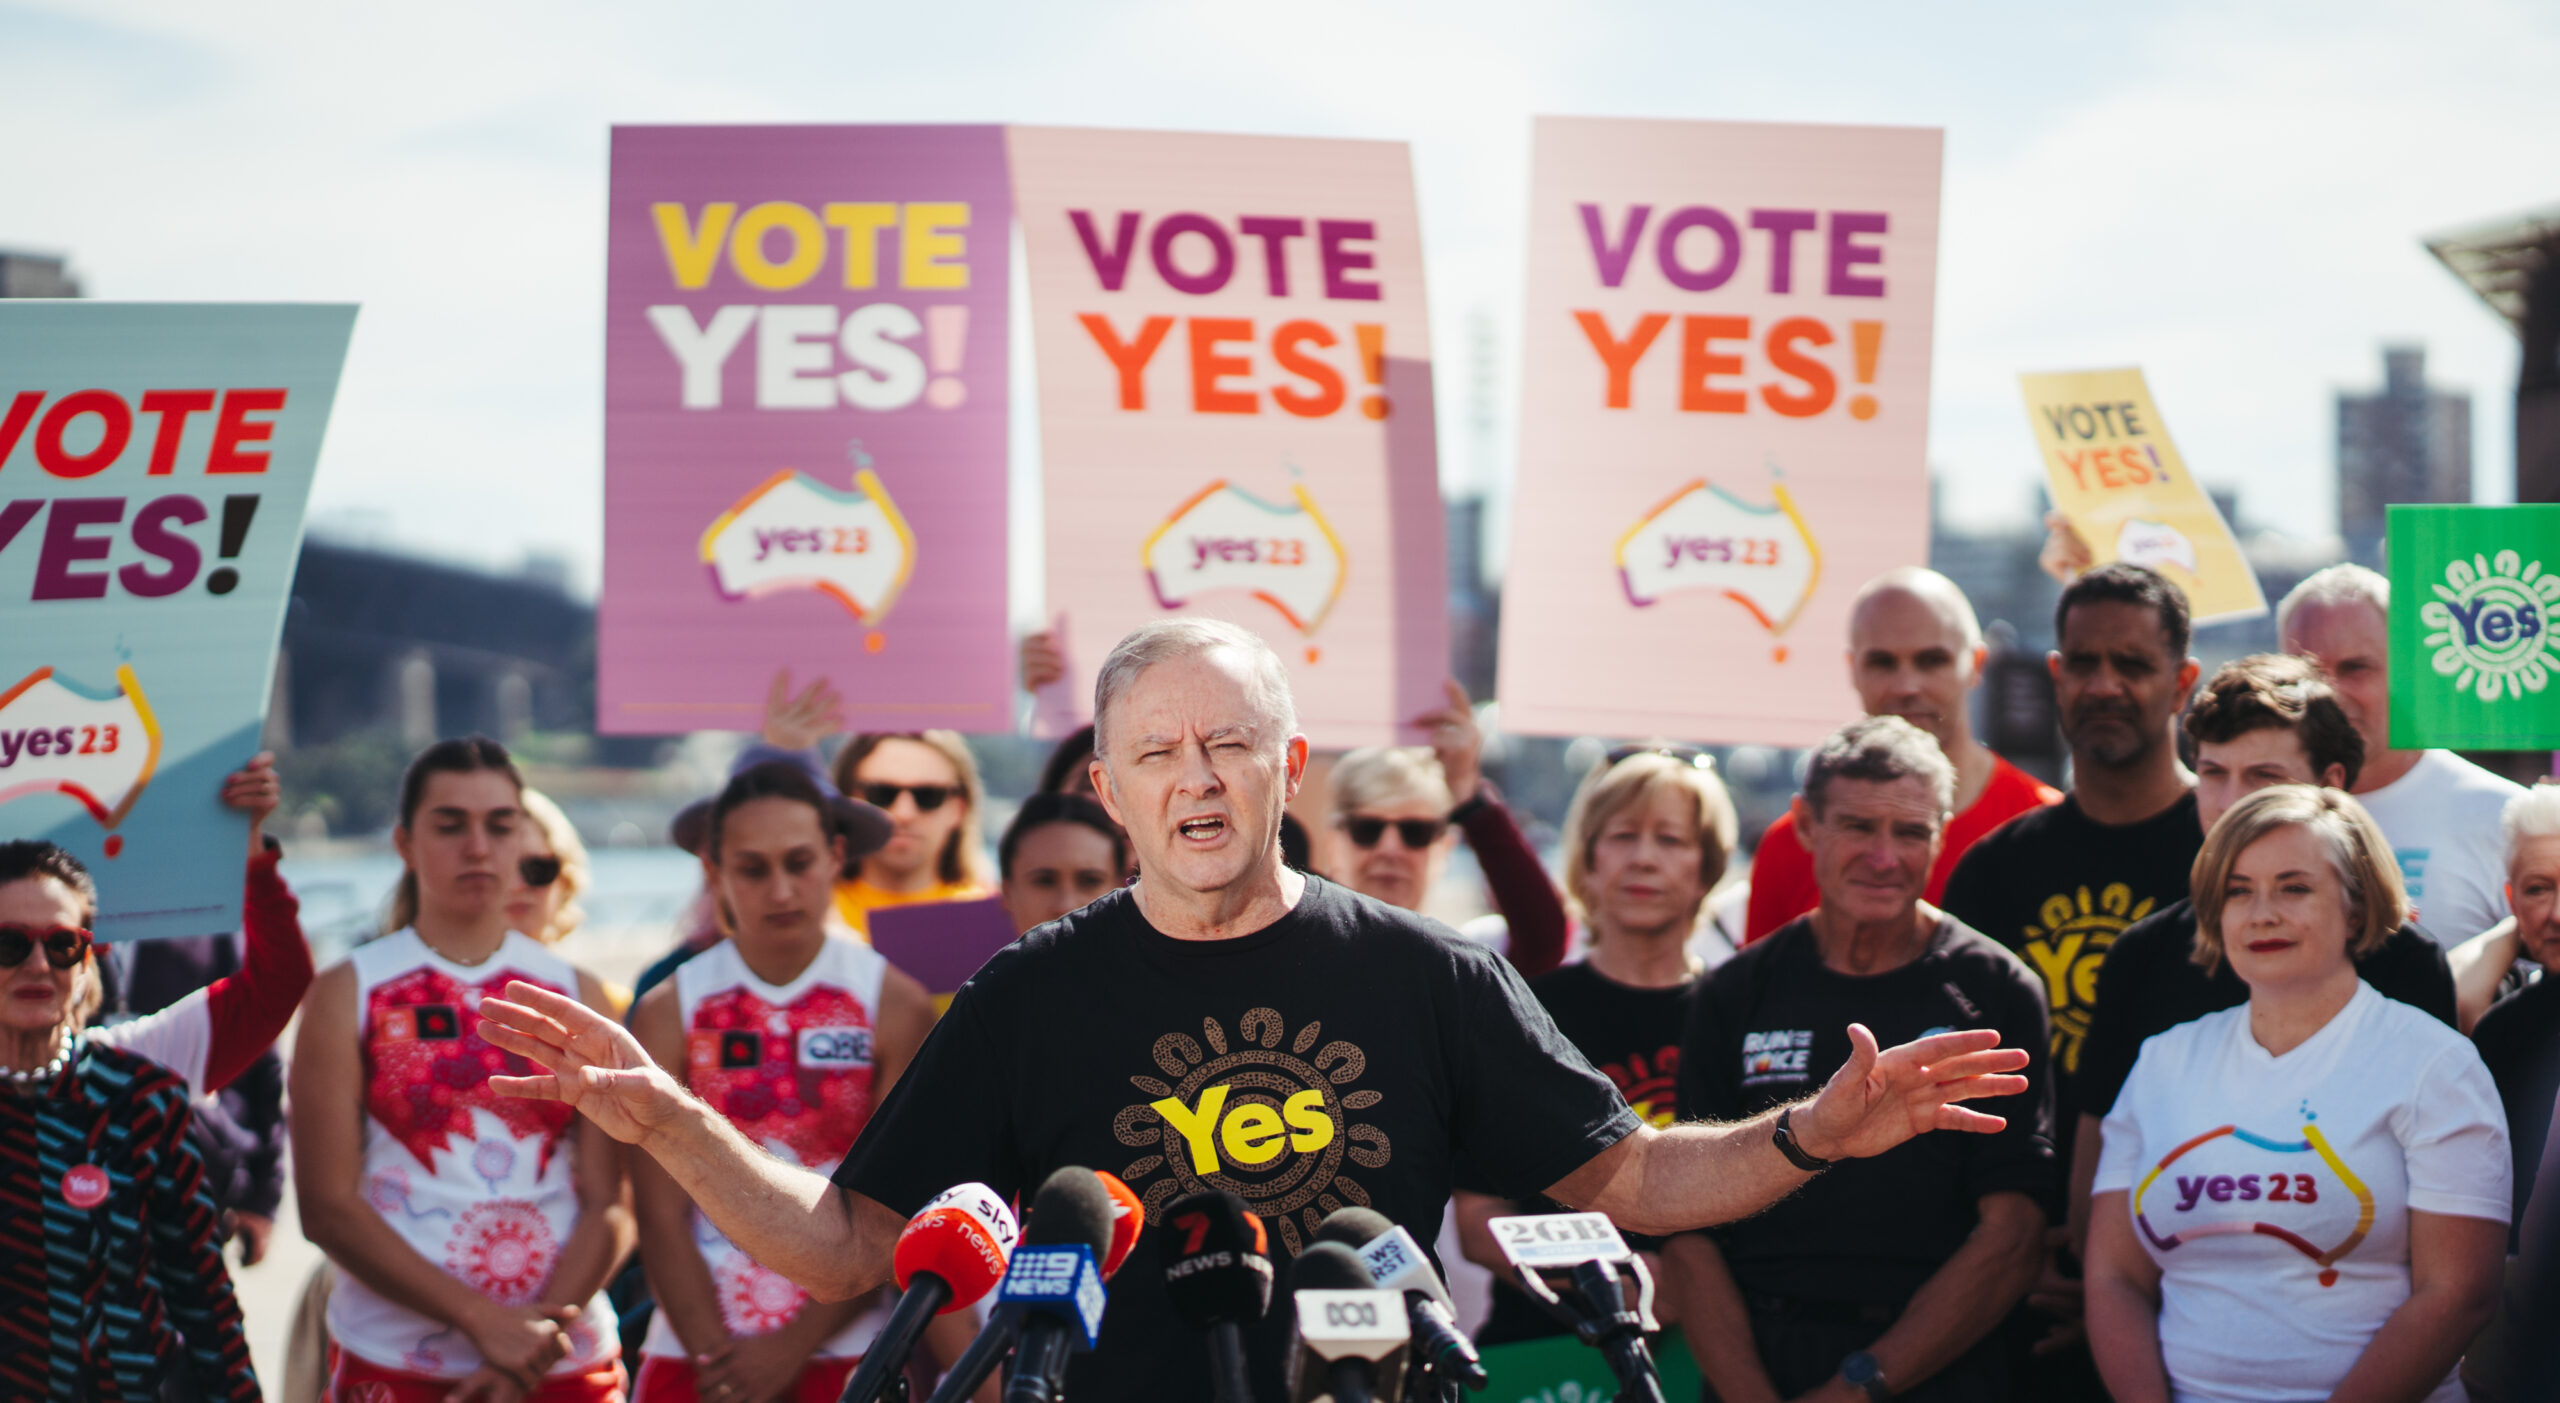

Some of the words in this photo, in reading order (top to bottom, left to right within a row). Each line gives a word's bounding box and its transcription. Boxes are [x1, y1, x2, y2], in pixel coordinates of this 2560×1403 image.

[653, 201, 972, 291] VOTE
[1067, 209, 1383, 302] VOTE
[1578, 204, 1890, 299] VOTE
[648, 302, 971, 412] YES!
[1076, 313, 1393, 421] YES!
[1573, 311, 1884, 421] YES!
[2042, 402, 2147, 440] VOTE
[2057, 443, 2170, 492] YES!
[2445, 597, 2541, 646] Yes
[2026, 933, 2106, 1008] Ye
[1149, 1084, 1335, 1176] Yes
[977, 1199, 1014, 1244] sky
[1173, 1210, 1211, 1256] 7
[1502, 1220, 1610, 1243] 2GB
[957, 1222, 1001, 1275] news
[1166, 1251, 1233, 1282] NEWS
[1366, 1239, 1400, 1263] WS
[1371, 1251, 1407, 1281] RST
[1005, 1278, 1072, 1296] NEWS
